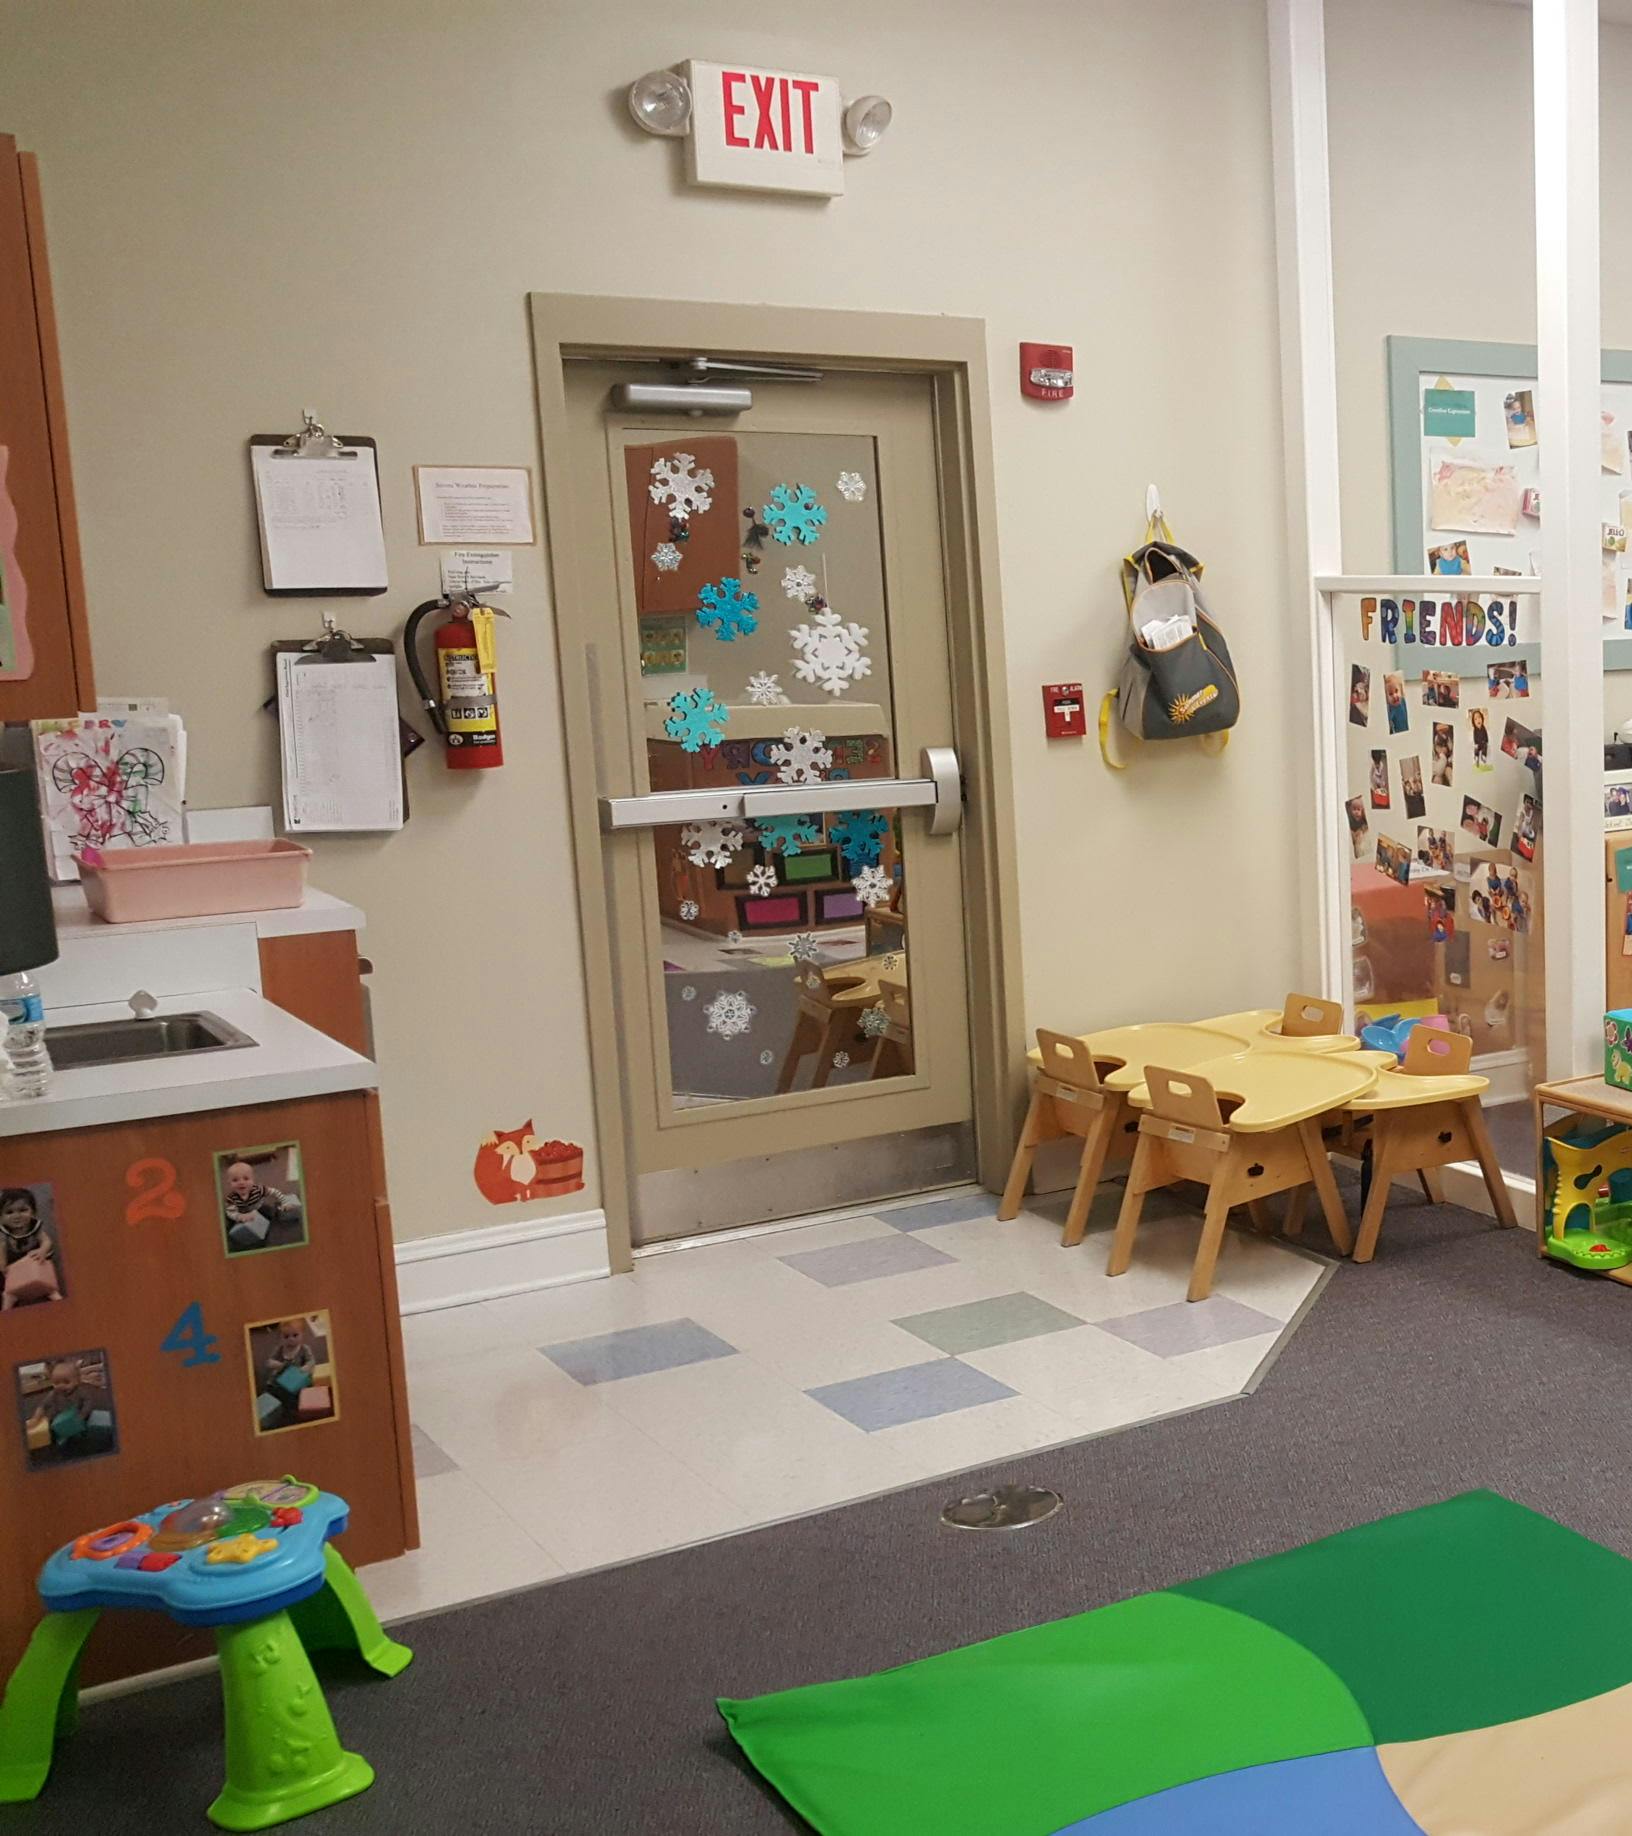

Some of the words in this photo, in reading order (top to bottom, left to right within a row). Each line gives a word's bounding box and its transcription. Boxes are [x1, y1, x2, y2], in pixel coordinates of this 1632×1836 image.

[722, 71, 819, 155] EXIT
[1041, 388, 1064, 398] FIRE
[1360, 596, 1518, 648] FRIENDS!
[126, 1157, 186, 1226] 2
[160, 1300, 222, 1368] 4
